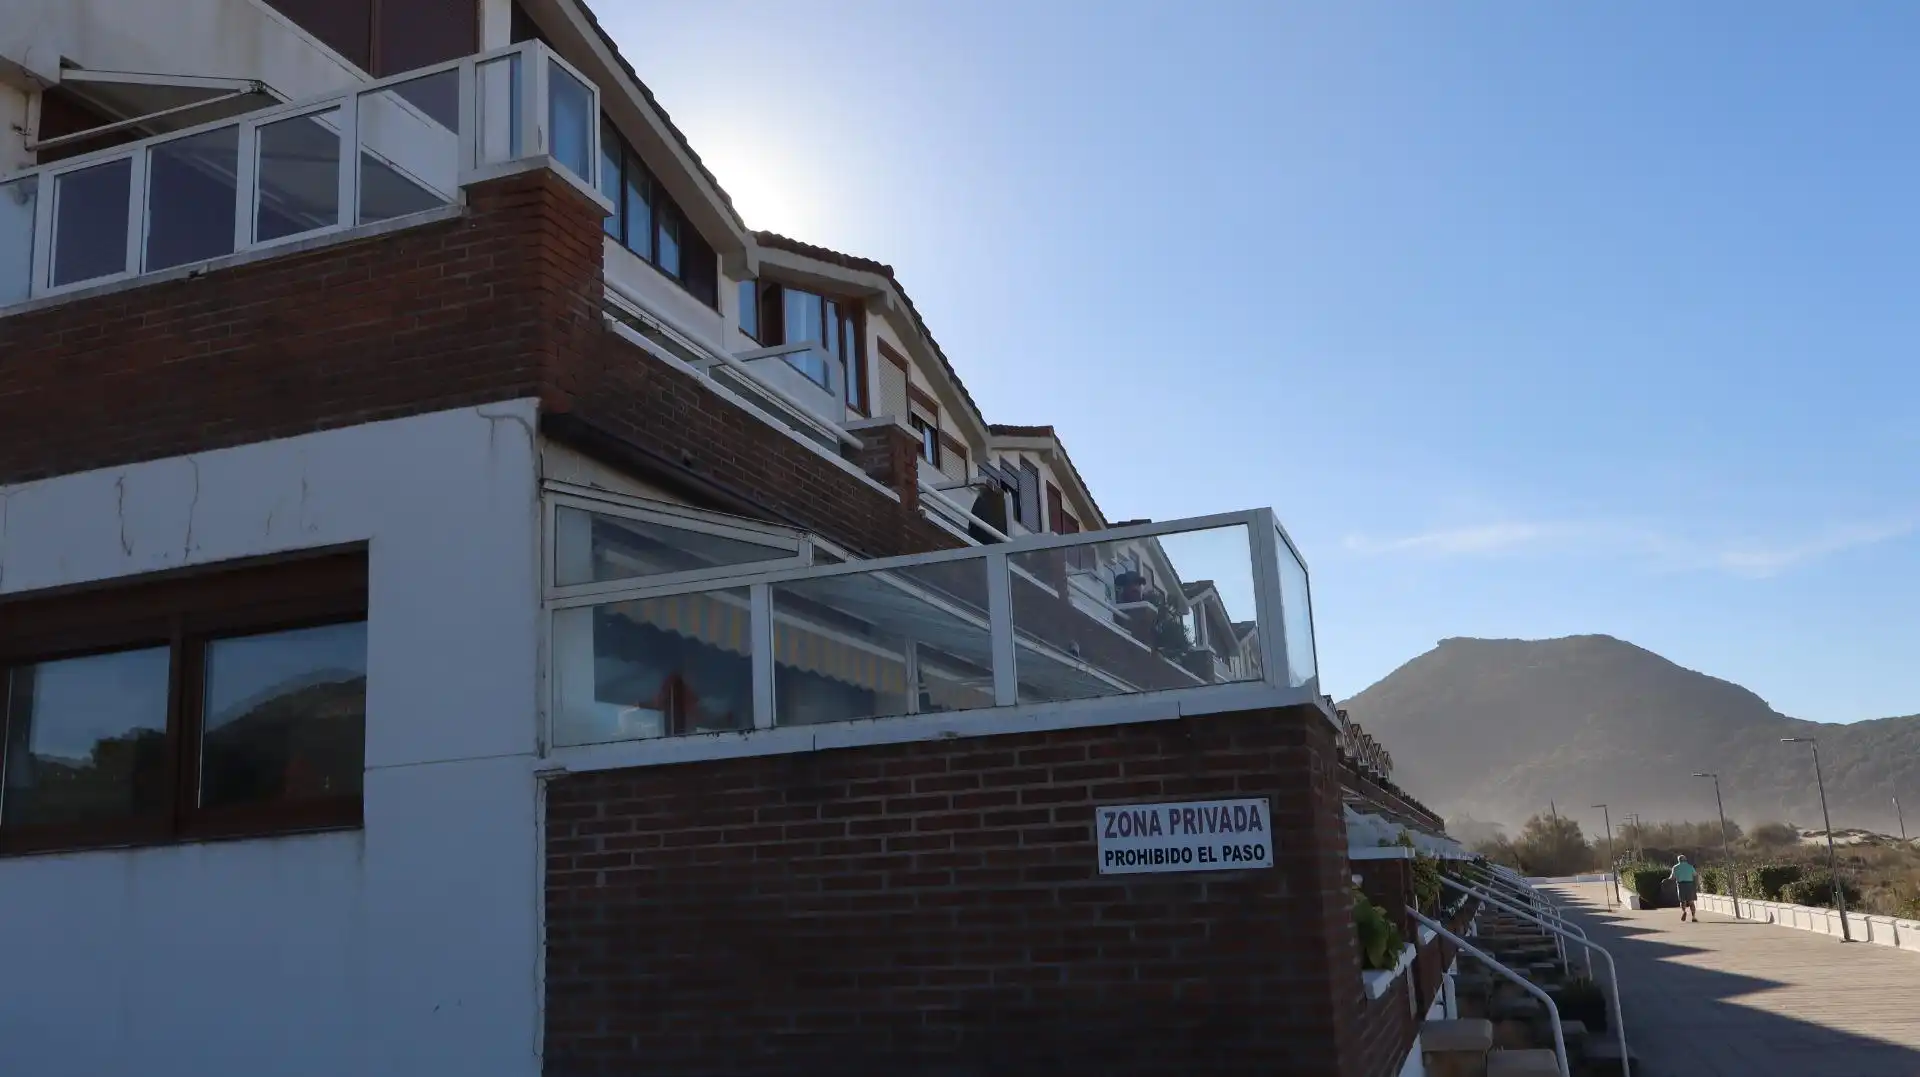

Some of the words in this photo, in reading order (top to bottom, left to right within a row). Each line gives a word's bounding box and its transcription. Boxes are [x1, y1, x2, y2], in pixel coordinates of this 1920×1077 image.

[1104, 810, 1162, 838] ZONA
[1168, 804, 1263, 835] PRIVADA
[1104, 847, 1193, 866] PROHIBIDO
[1198, 846, 1217, 863] EL
[1222, 844, 1265, 862] PASO
